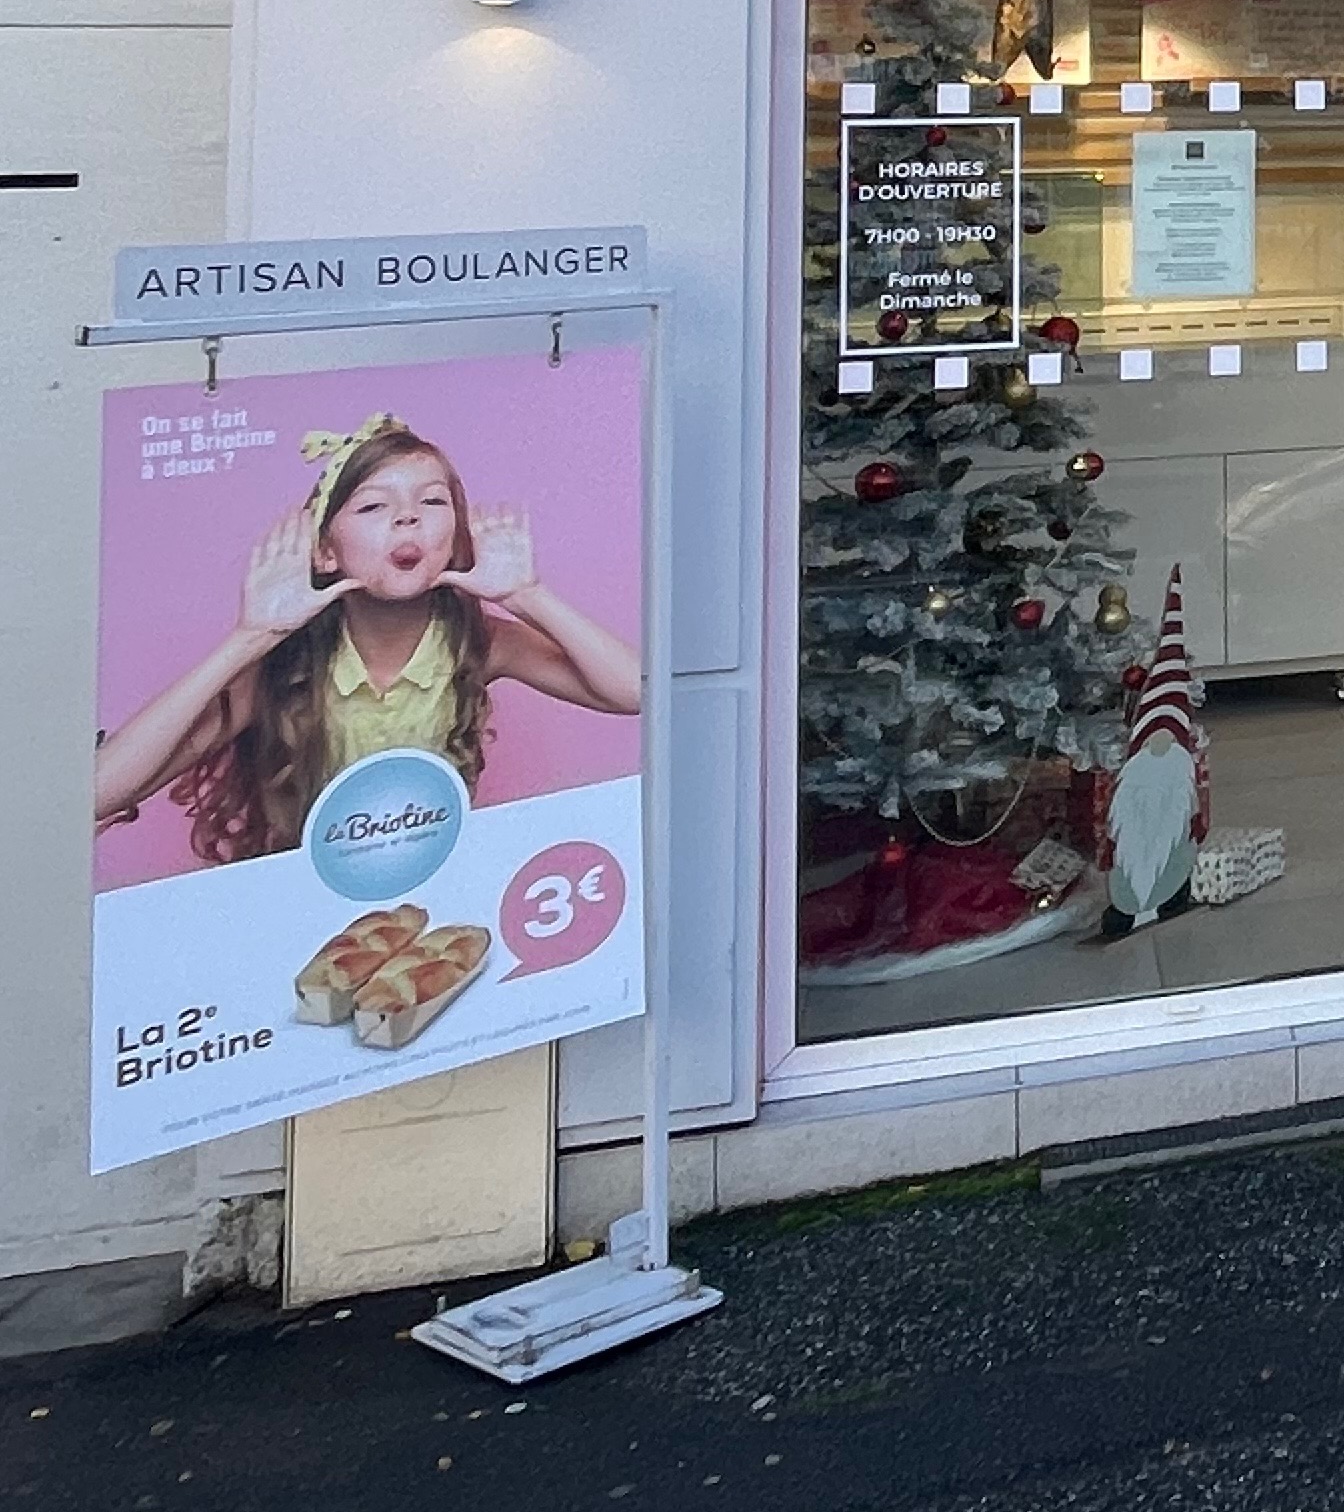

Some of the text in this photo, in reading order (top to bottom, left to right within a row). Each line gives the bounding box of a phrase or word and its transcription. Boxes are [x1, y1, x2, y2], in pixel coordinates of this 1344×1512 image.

[878, 160, 985, 180] HORAIRES
[858, 181, 1004, 202] D'OUVERTURE
[864, 226, 921, 245] 7H00
[936, 224, 997, 243] 19H30
[136, 244, 631, 300] ARTISAN BOULANGER
[887, 268, 974, 288] Fermé le
[879, 289, 983, 311] Dimanche
[142, 416, 172, 436] On
[142, 429, 278, 458] une Briotine
[163, 456, 216, 478] deux
[523, 864, 607, 939] 3€
[117, 1024, 165, 1055] La
[116, 1027, 274, 1088] Briotine
